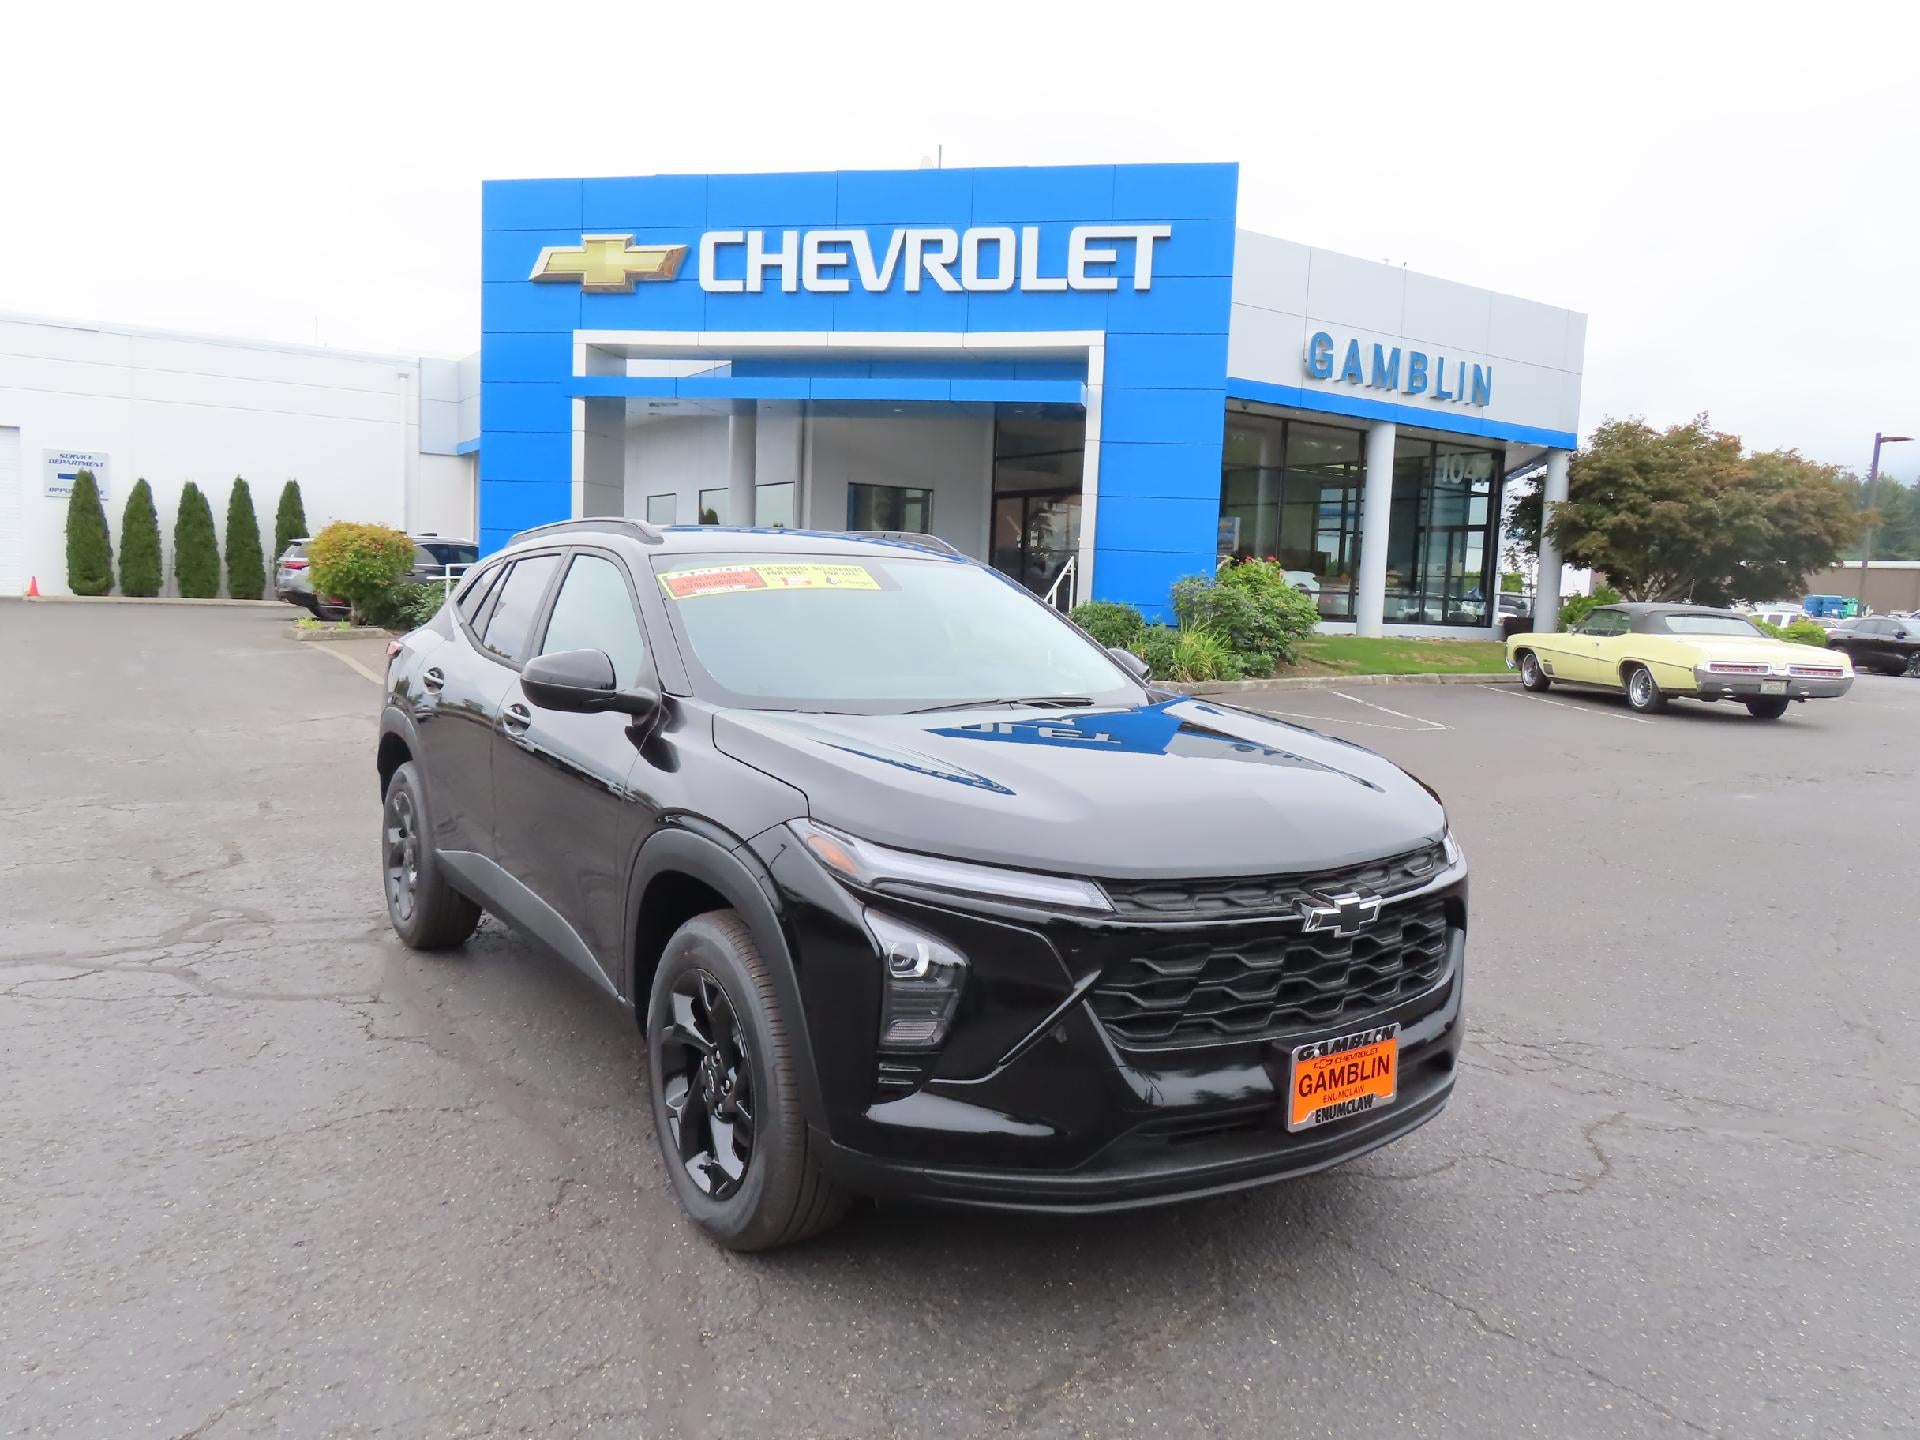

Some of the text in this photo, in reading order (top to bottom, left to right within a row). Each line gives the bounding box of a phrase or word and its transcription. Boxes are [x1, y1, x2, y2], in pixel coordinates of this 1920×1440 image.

[699, 225, 1172, 292] CHEVROLET
[1309, 331, 1493, 407] GAMBLIN
[1298, 1025, 1396, 1061] GAMBLIN
[1334, 1047, 1379, 1065] CHEVROLET
[1298, 1054, 1390, 1098] GAMBLIN
[1315, 1093, 1375, 1123] ENUMCLAW
